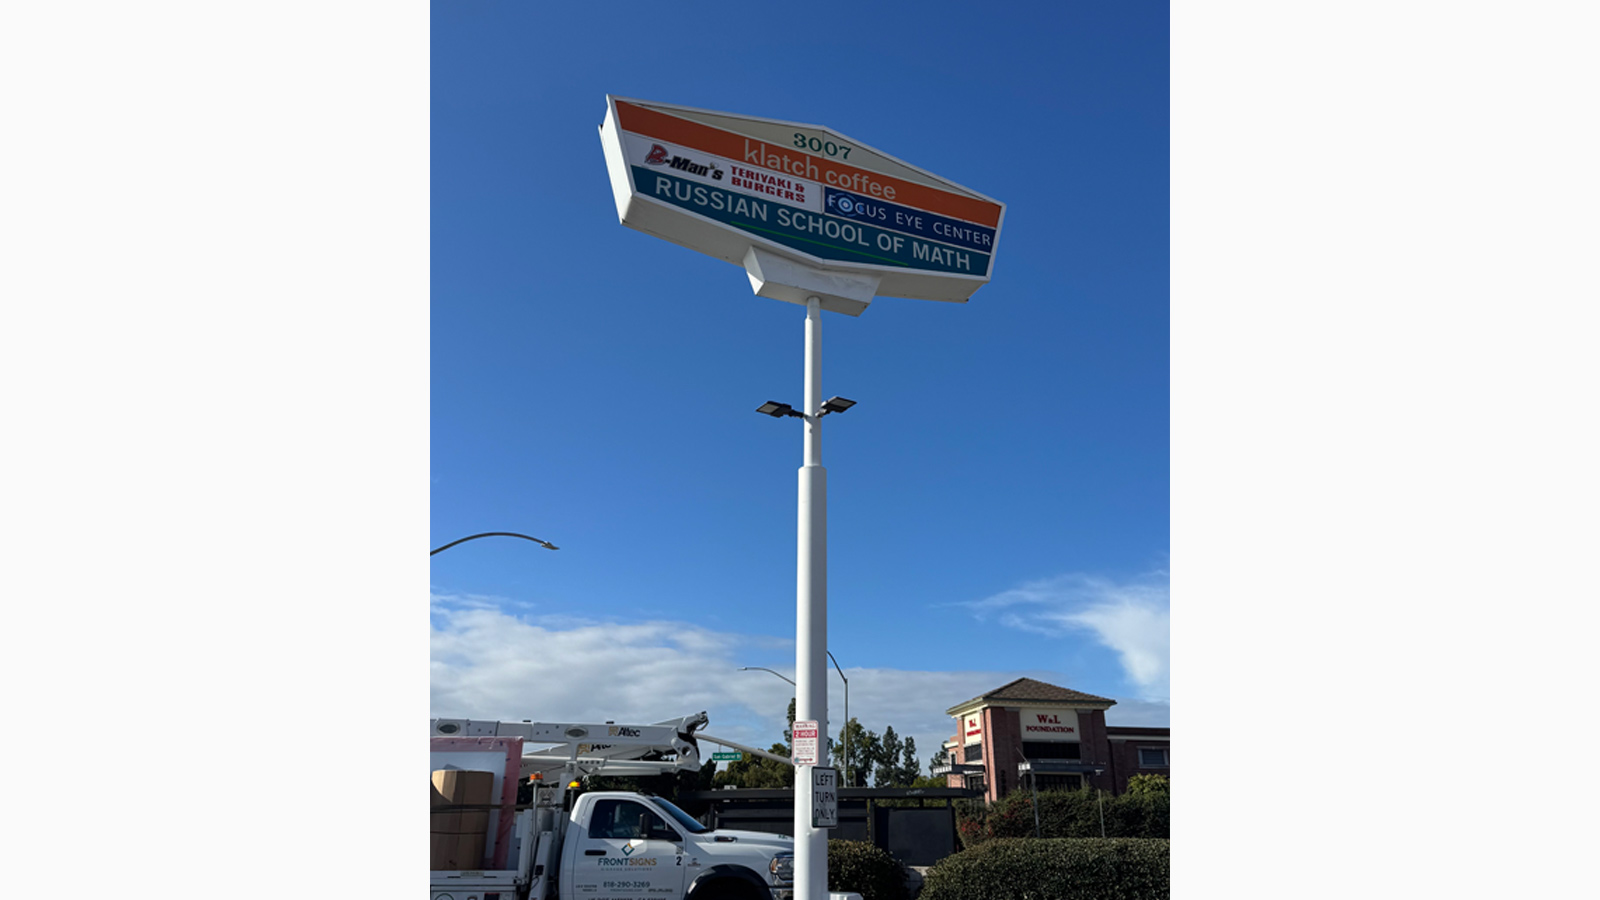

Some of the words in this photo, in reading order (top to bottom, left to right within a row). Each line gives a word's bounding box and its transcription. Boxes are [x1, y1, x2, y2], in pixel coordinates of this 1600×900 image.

[793, 132, 852, 160] 3007
[644, 143, 724, 181] B-Man's
[744, 139, 819, 181] klatch
[825, 170, 897, 200] coffee
[730, 165, 791, 189] TERIYAKI
[795, 182, 805, 192] &
[731, 176, 805, 203] BURGERS
[655, 176, 767, 222] RUSSIAN
[777, 208, 870, 247] SCHOOL
[877, 233, 905, 254] OF
[913, 241, 971, 271] MATH
[827, 193, 887, 221] FOCUS
[895, 212, 923, 230] EYE
[933, 222, 991, 246] CENTER
[1037, 714, 1061, 724] W&L
[617, 726, 641, 737] Altec
[1026, 725, 1074, 733] FOUNDATION
[815, 774, 833, 786] LEFT
[815, 791, 835, 803] TURN
[815, 808, 835, 820] ONLY
[597, 857, 657, 866] FRONTSIGNS
[675, 856, 682, 866] 2
